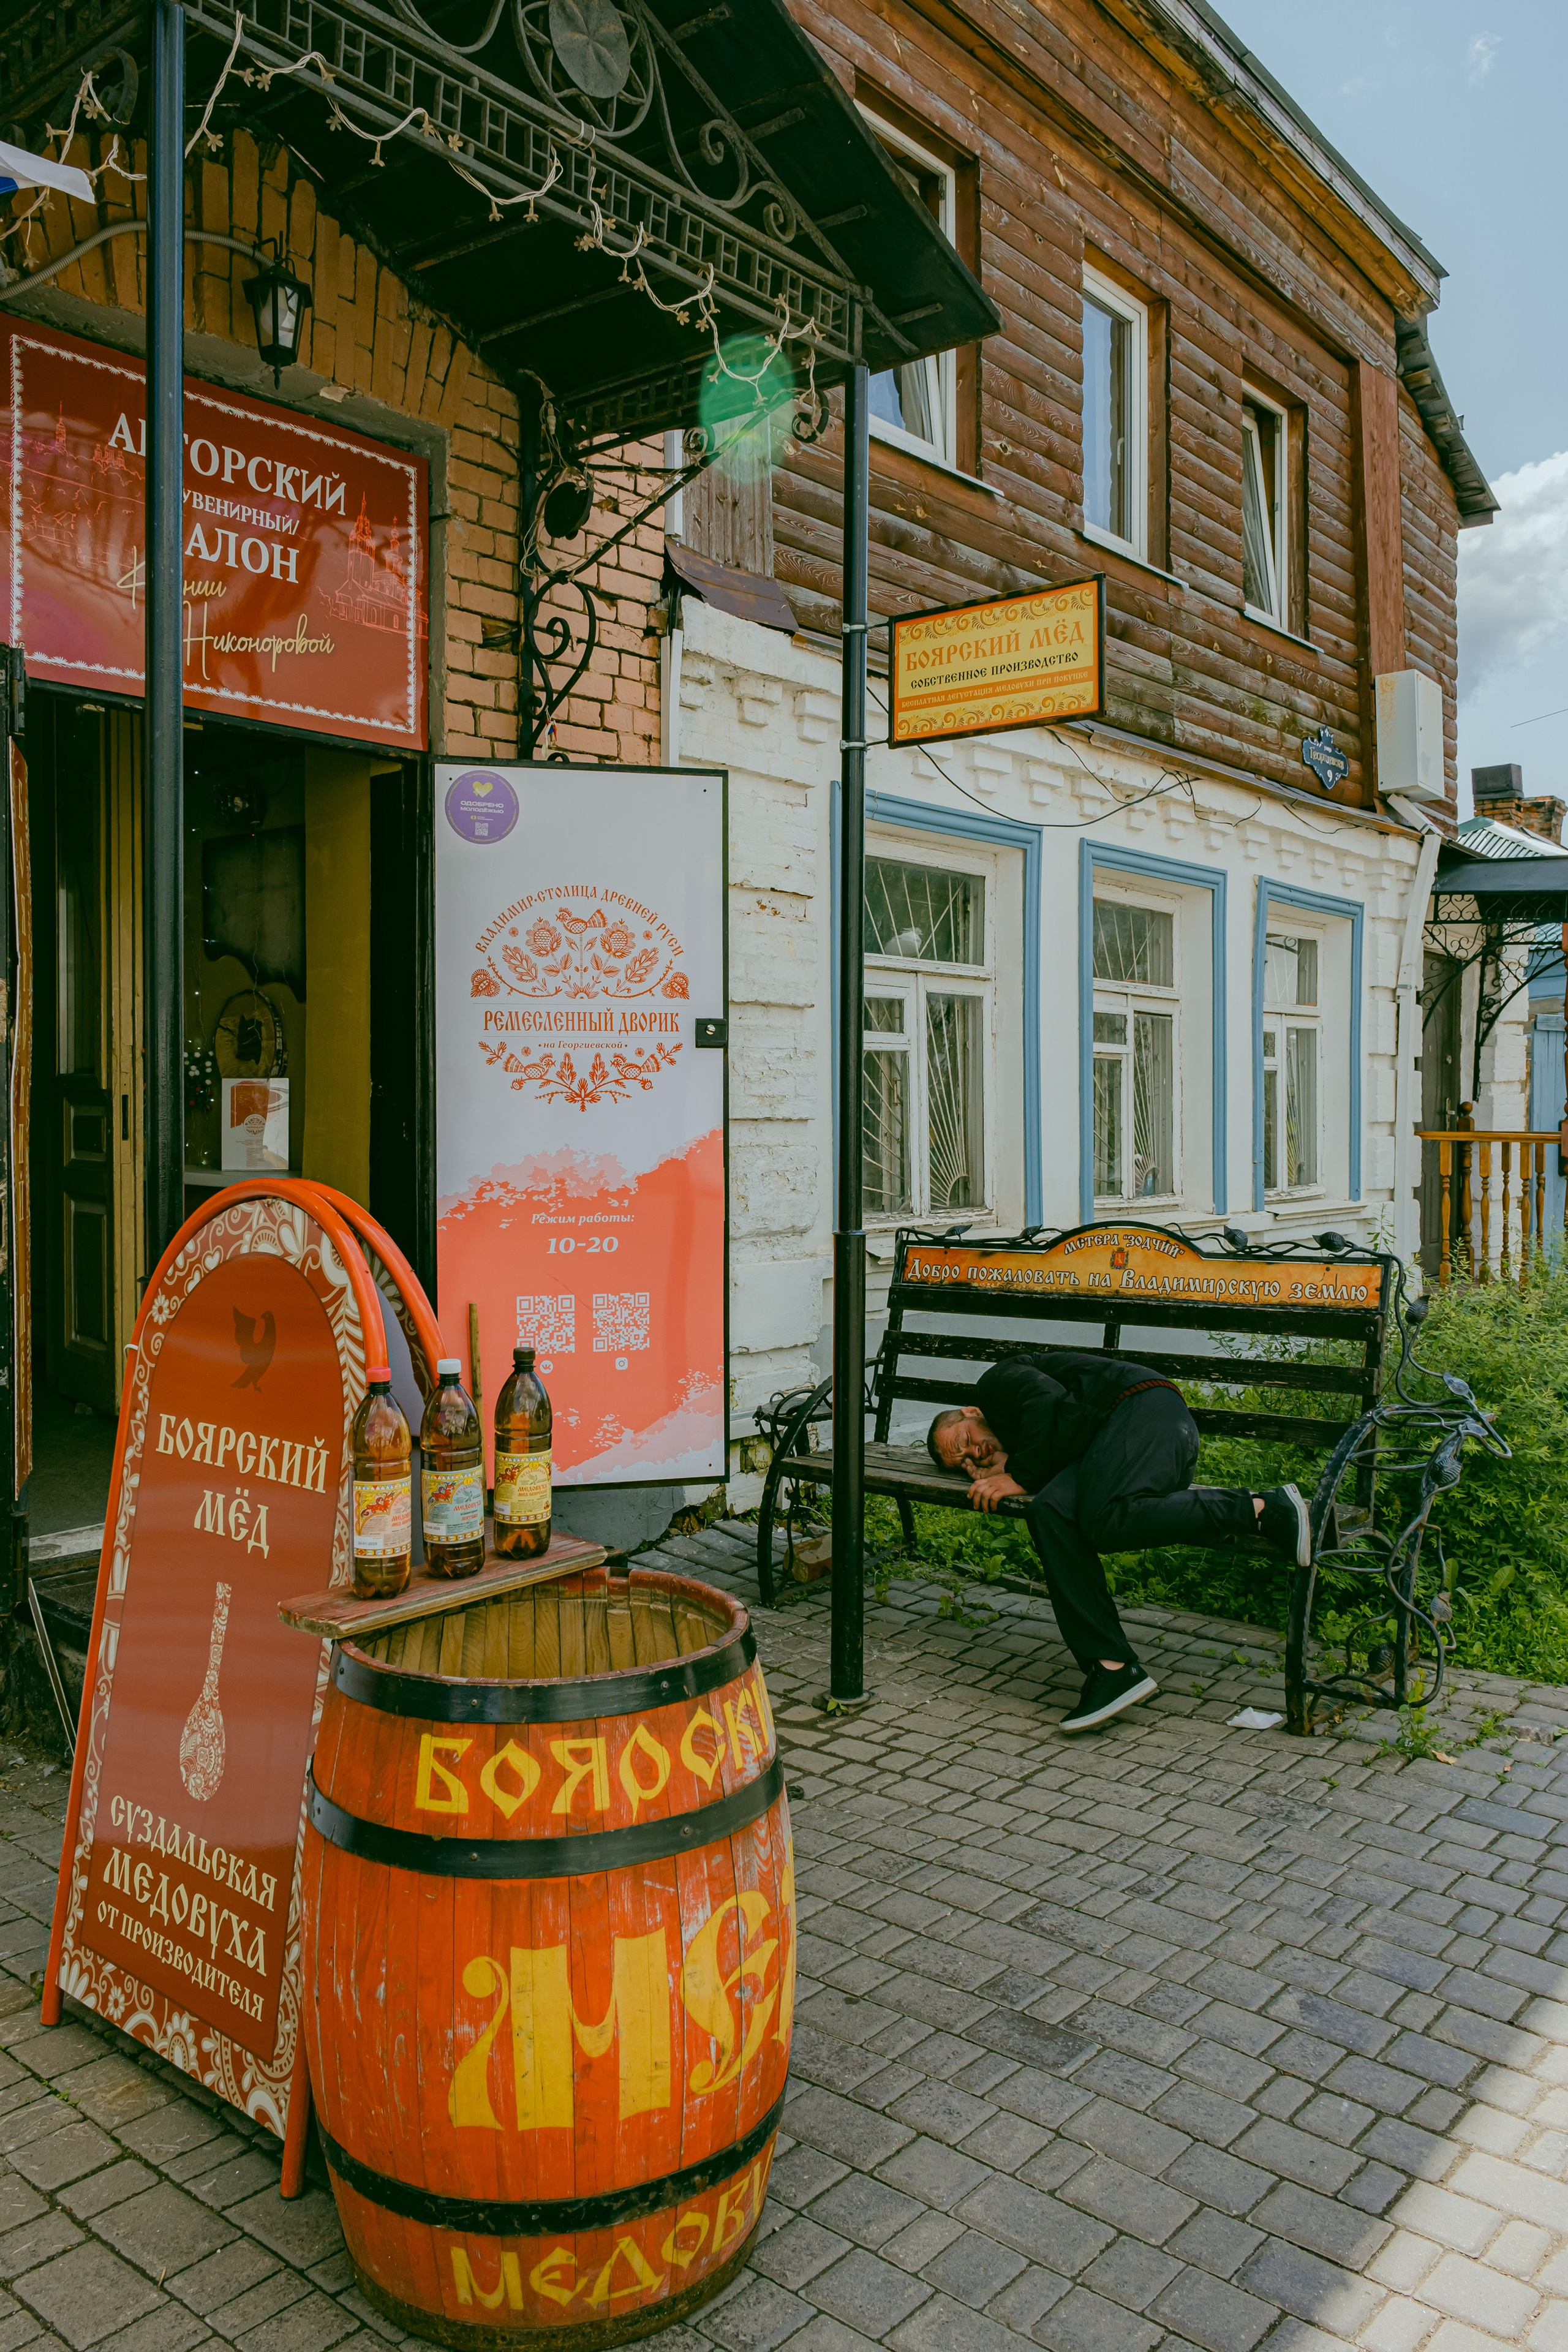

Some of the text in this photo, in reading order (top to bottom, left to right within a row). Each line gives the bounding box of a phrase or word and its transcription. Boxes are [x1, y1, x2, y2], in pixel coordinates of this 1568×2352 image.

[108, 412, 347, 516] АОРСКИЙ
[116, 545, 227, 610] Книи
[184, 522, 300, 584] АЛОН
[905, 618, 1085, 672] БОЯРСКИЙ МЁД
[910, 651, 1079, 690] СОБСТВЕННОЕ ПРОИЗВОДСТВО
[901, 671, 1089, 709] БЕСПЛАТНАЯ ДЕГУСТАЦИЯ МЕДОВУХИ ПРИ ПОКУПКЕ
[1327, 769, 1333, 782] 9
[460, 800, 504, 809] ОДОБРЕНО
[600, 889, 661, 926] ДРЕВНЕЙ
[655, 922, 685, 957] РУСИ
[18, 778, 27, 1221] БОЯРСКИЙ
[483, 1007, 680, 1036] РЕМЕСЛЕННЫЙ ДВОРИК
[558, 1041, 623, 1051] Георгиевской
[531, 1212, 635, 1226] Режим работы:
[546, 1236, 619, 1254] 10-20
[1064, 1232, 1120, 1256] МСТЕРА
[907, 1257, 1368, 1302] Добро пожаловать на Владимирскую землю
[156, 1412, 330, 1494] БОЯРСКИЙ
[194, 1487, 270, 1559] МЁД
[110, 1795, 278, 1912] СУЗДАЛЬСКАЯ
[103, 1846, 268, 1977] МЕДОВУХА
[97, 1900, 265, 2022] ОТ ПРОИЗВОДИТЕЛЯ
